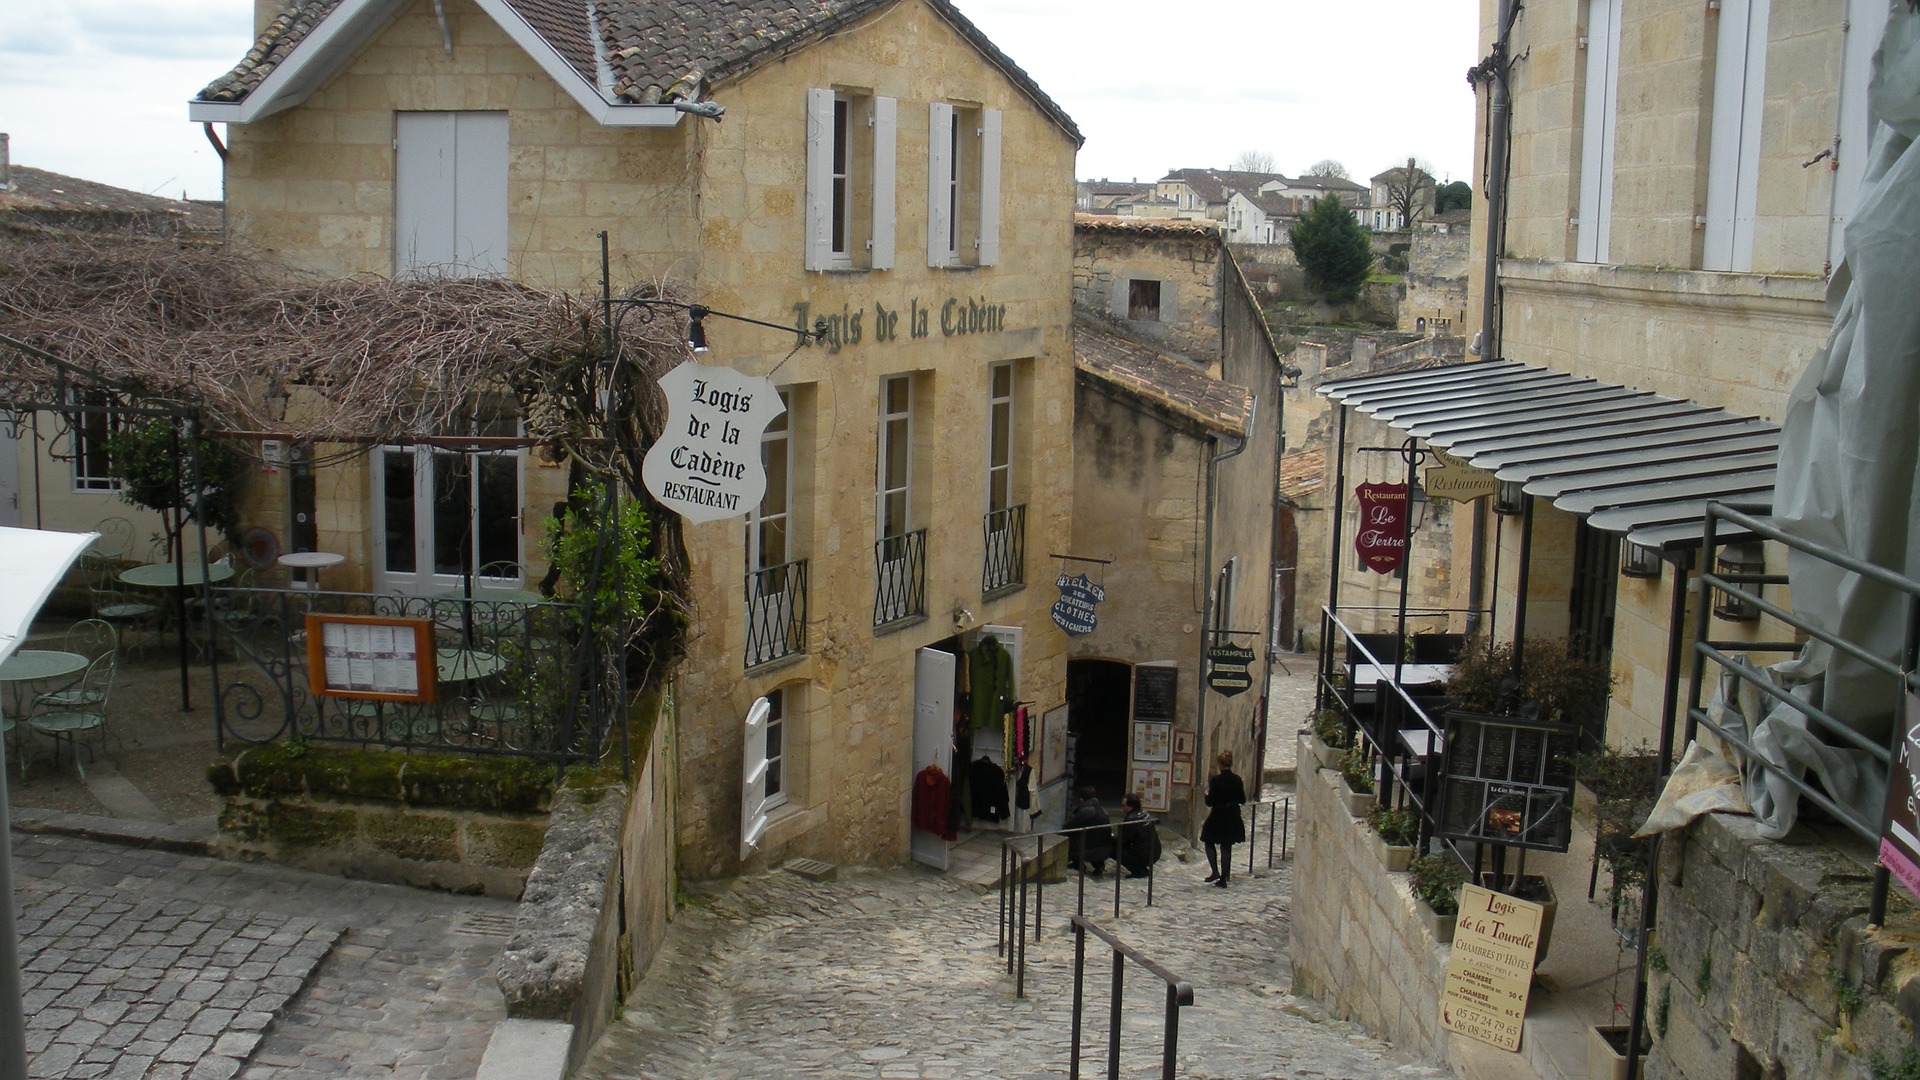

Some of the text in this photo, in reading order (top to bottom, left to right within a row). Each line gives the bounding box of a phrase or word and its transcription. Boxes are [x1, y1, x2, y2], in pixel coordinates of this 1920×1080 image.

[876, 300, 899, 342] de
[910, 297, 929, 339] la
[941, 294, 1006, 337] Cadène
[691, 379, 752, 413] Logis
[687, 413, 740, 445] de la
[670, 445, 746, 481] Cadène
[662, 481, 740, 511] RESTAURANT
[1364, 489, 1406, 502] Restaurant
[1370, 505, 1396, 525] Le
[1360, 530, 1405, 548] Tertre
[1072, 590, 1086, 598] DES
[1052, 612, 1092, 633] DESIGNERS
[1054, 602, 1096, 624] CLOTHES
[1485, 893, 1516, 917] Logis
[1459, 916, 1534, 949] de la Tourelle
[1455, 938, 1495, 960] CHAMBRES
[1463, 969, 1492, 985] CHAMBRE
[1460, 986, 1489, 1002] CHAMBRE
[1508, 991, 1517, 999] 50
[1456, 1008, 1518, 1036] 05 57 24 79 65
[1505, 1009, 1514, 1017] 65
[1454, 1020, 1515, 1048] 06 08 25 14 51
